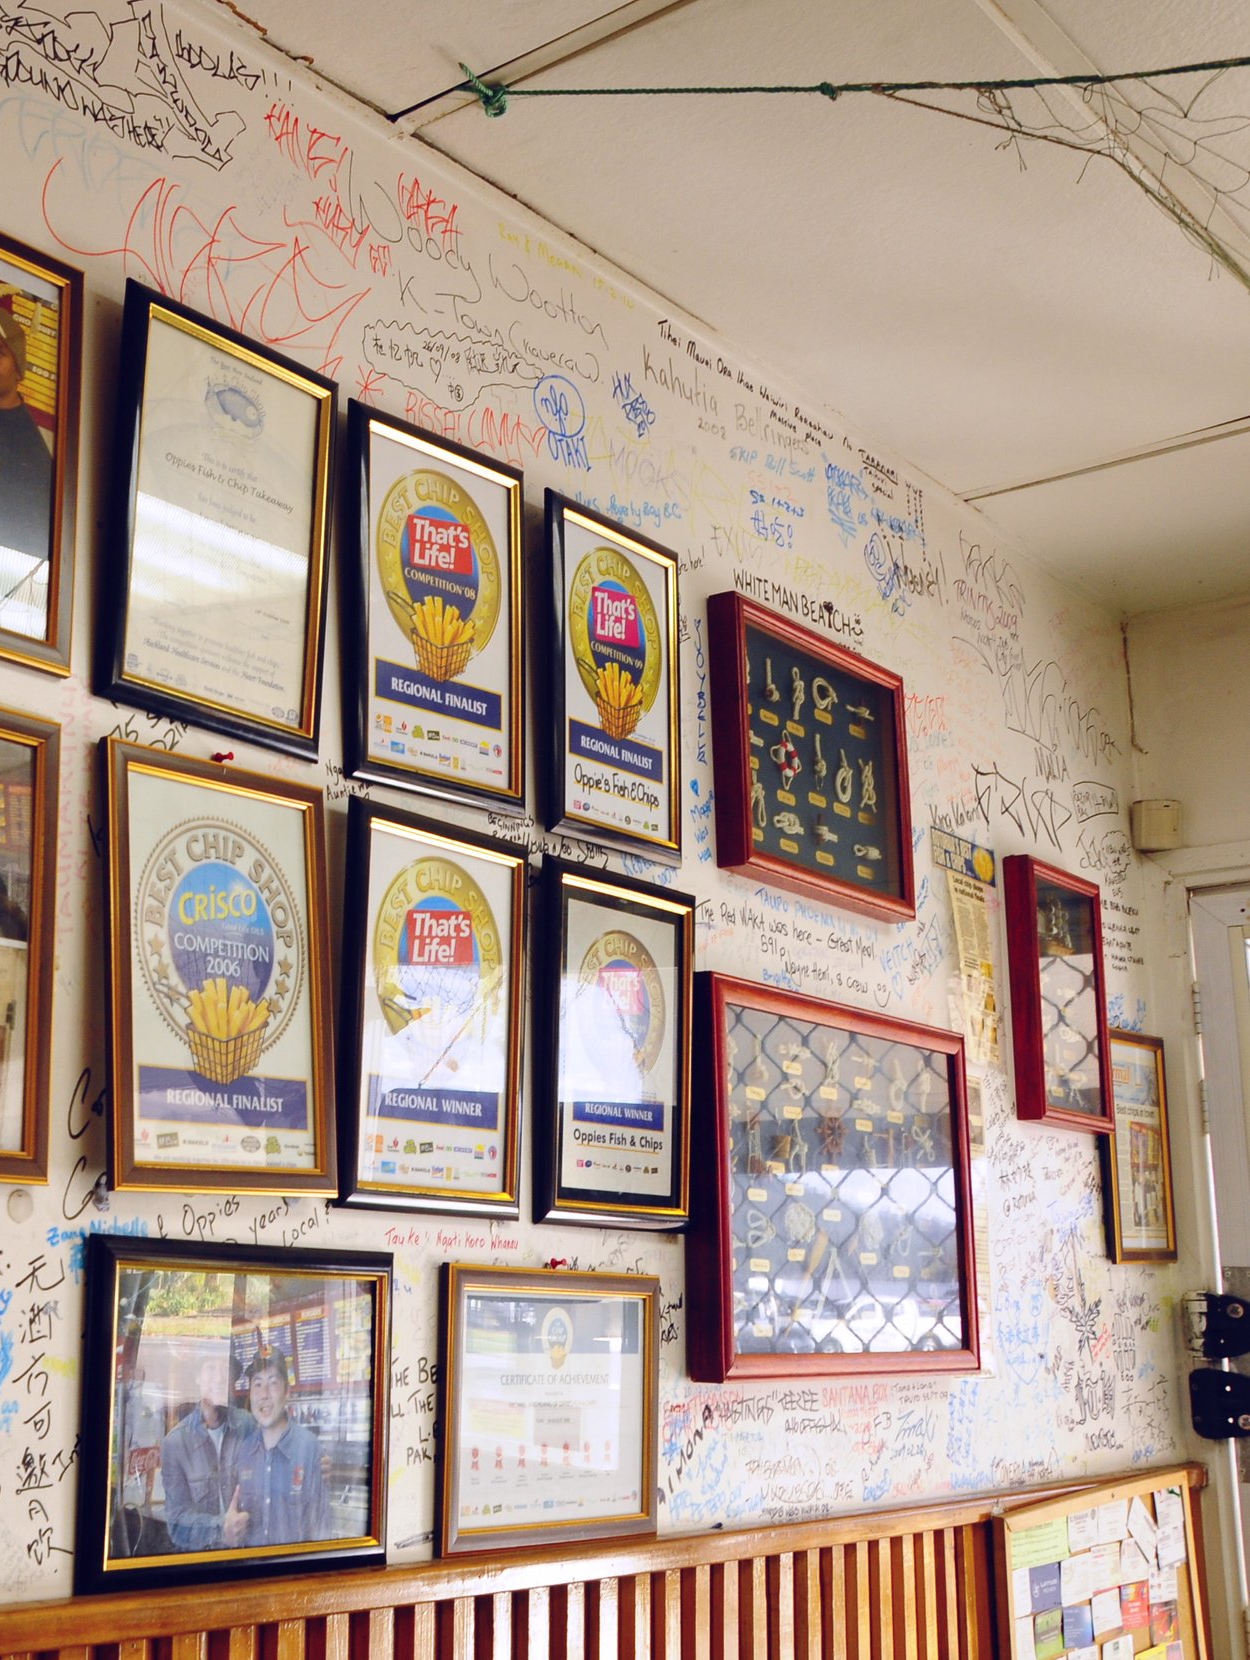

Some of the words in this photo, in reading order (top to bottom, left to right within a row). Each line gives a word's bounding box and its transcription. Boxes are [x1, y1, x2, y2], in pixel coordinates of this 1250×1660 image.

[165, 452, 196, 472] Oppies
[198, 465, 217, 481] Fish
[227, 477, 249, 497] Chip
[251, 487, 294, 515] Takeaway
[382, 486, 410, 549] BEST
[413, 477, 461, 510] CHIP
[462, 504, 497, 585] SHOP
[412, 518, 470, 549] That's
[412, 543, 456, 570] Life!
[573, 565, 595, 618] BEST
[596, 555, 632, 584] CHIP
[634, 578, 658, 651] SHOP
[594, 589, 636, 621] That's
[595, 613, 627, 641] Life!
[391, 676, 443, 704] REGIONAL
[444, 691, 488, 717] FINALIST
[580, 733, 620, 761] REGIONAL
[621, 748, 654, 771] FINALIST
[144, 856, 184, 928] BEST
[186, 831, 247, 866] CHIP
[247, 858, 295, 951] SHOP
[379, 882, 414, 951] BEST
[415, 867, 463, 895] CHIP
[464, 895, 498, 971] SHOP
[412, 912, 472, 938] That's
[174, 932, 271, 965] COMPETITION
[412, 938, 457, 964] Life!
[603, 936, 638, 959] CHIP
[205, 957, 242, 978] 2006
[600, 969, 642, 993] That's
[166, 1088, 231, 1108] REGIONAL
[232, 1093, 284, 1113] FINALIST
[384, 1091, 440, 1112] REGIONAL
[442, 1097, 484, 1118] WINNER
[584, 1103, 623, 1120] REGIONAL
[624, 1107, 654, 1122] WINNER
[1116, 1104, 1127, 1115] Best
[572, 1128, 608, 1146] Oppies
[609, 1131, 628, 1147] Fish
[629, 1136, 637, 1148] &
[639, 1135, 664, 1152] Chips
[500, 1373, 547, 1387] CERTIFICATE
[547, 1374, 558, 1386] OF
[559, 1373, 610, 1385] ACHIEVEMENT
[408, 1390, 434, 1414] THE
